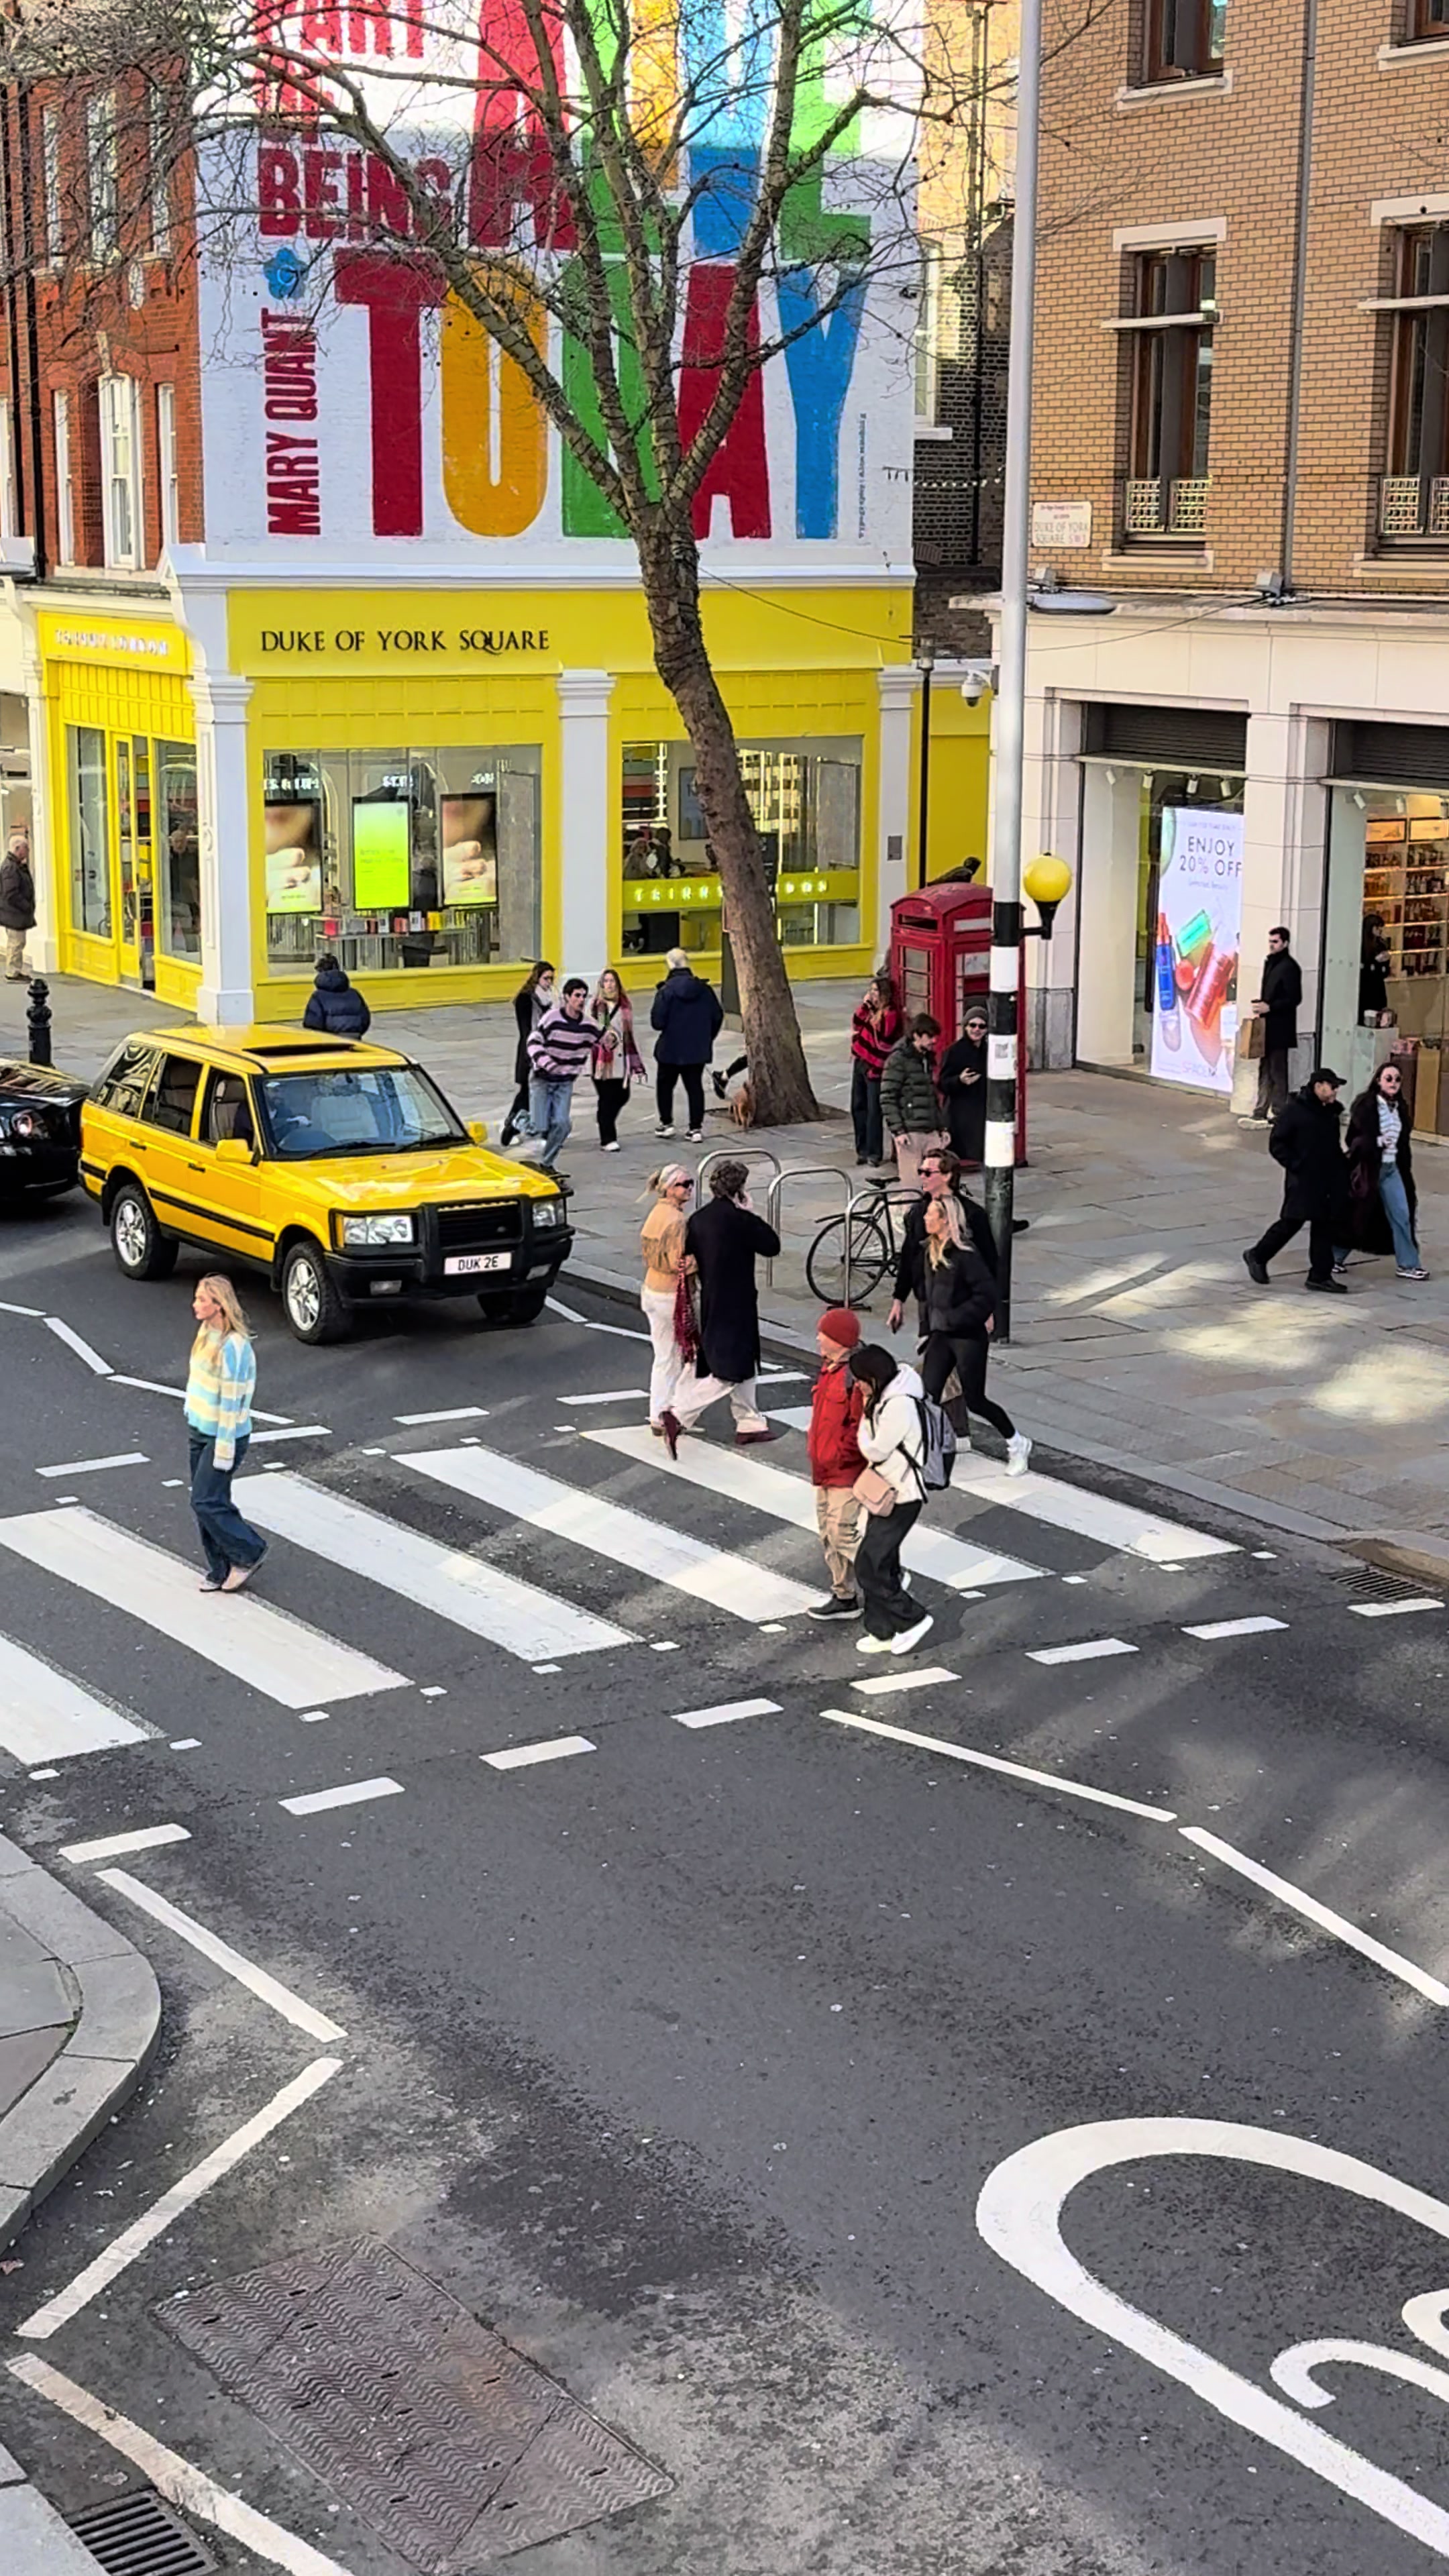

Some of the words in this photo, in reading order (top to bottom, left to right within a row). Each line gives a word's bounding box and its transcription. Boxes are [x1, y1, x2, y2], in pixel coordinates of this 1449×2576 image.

[262, 307, 318, 421] QUANT
[334, 246, 870, 541] TODAY
[267, 431, 321, 535] MARY
[261, 630, 326, 651] DUKE
[335, 630, 366, 651] OF
[377, 629, 447, 651] YORK
[459, 629, 551, 655] SQUARE
[1188, 836, 1235, 856] ENJOY
[1180, 855, 1209, 874] 20%
[1214, 859, 1242, 877] OFF
[458, 1257, 481, 1271] DUK
[484, 1255, 499, 1269] 2E
